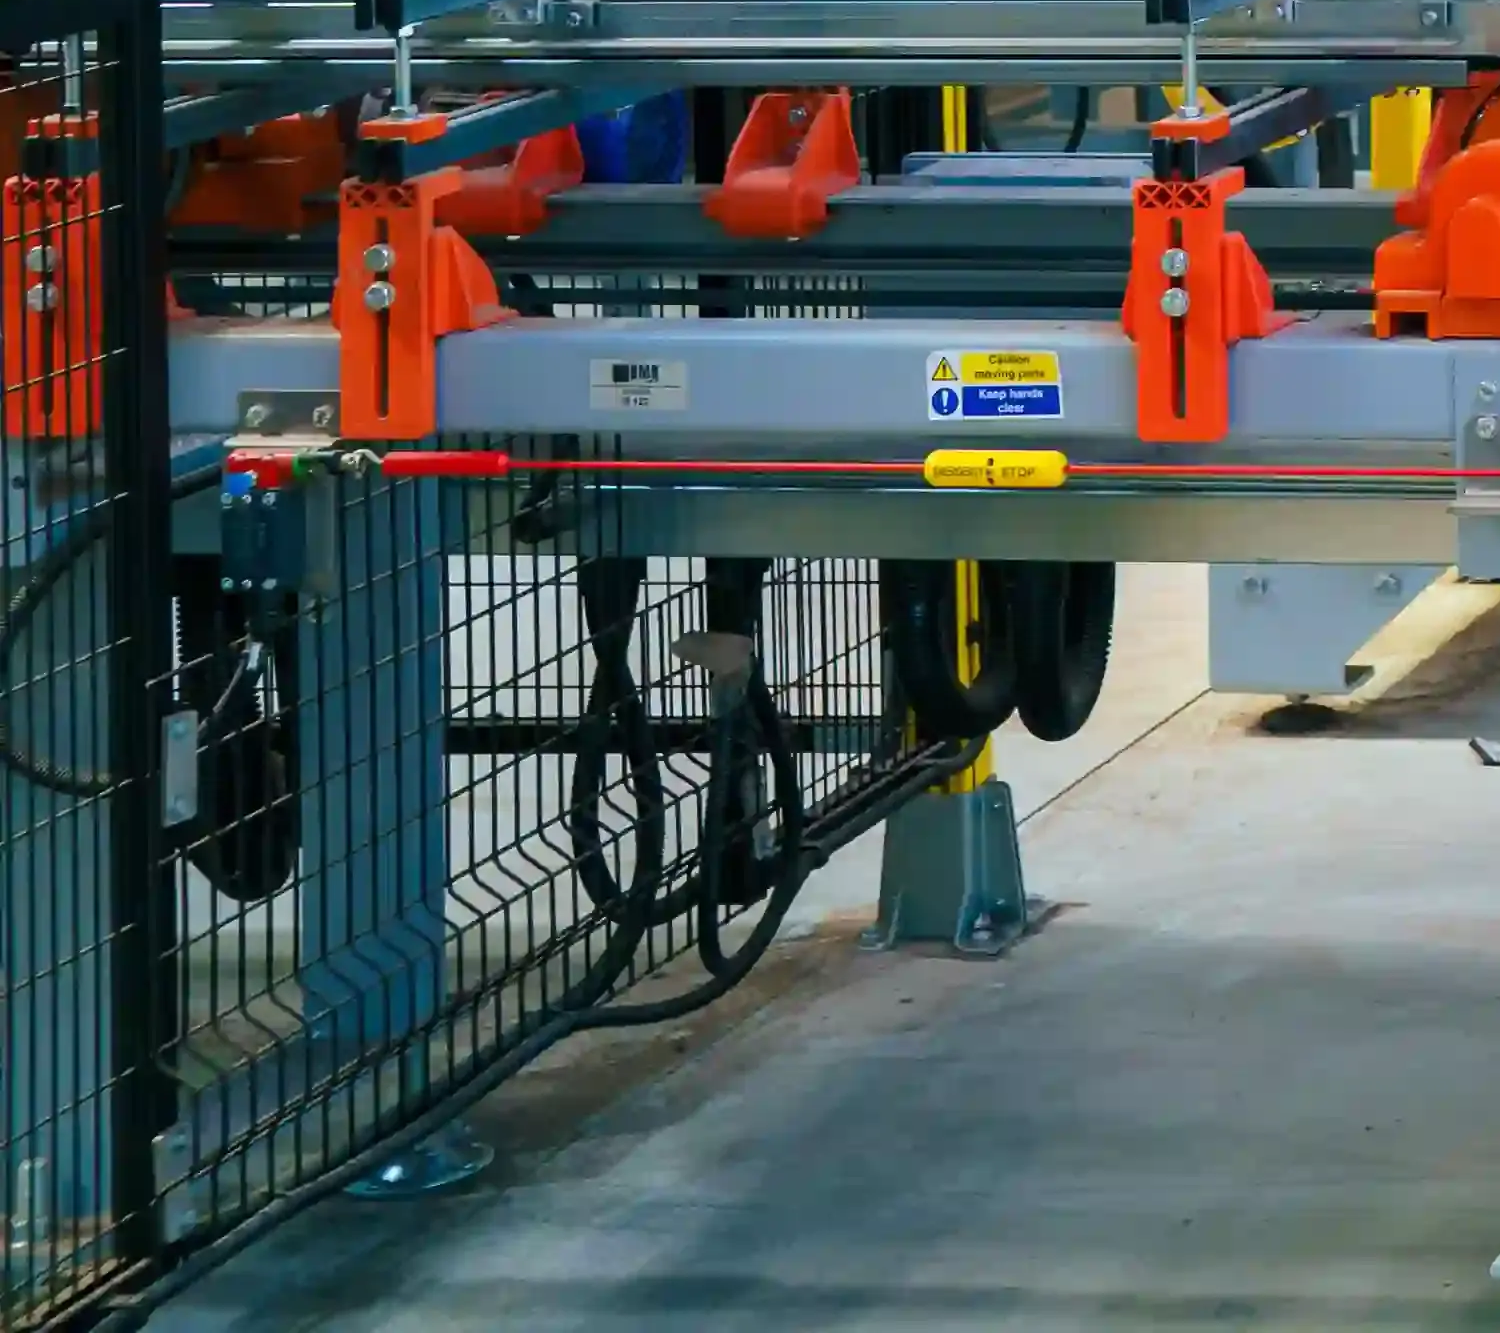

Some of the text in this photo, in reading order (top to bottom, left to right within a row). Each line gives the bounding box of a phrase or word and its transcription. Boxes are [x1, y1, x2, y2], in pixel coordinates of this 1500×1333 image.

[989, 354, 1030, 365] Caution
[974, 370, 1045, 381] moving parts
[979, 388, 1044, 400] Keep hands
[998, 402, 1025, 414] clear
